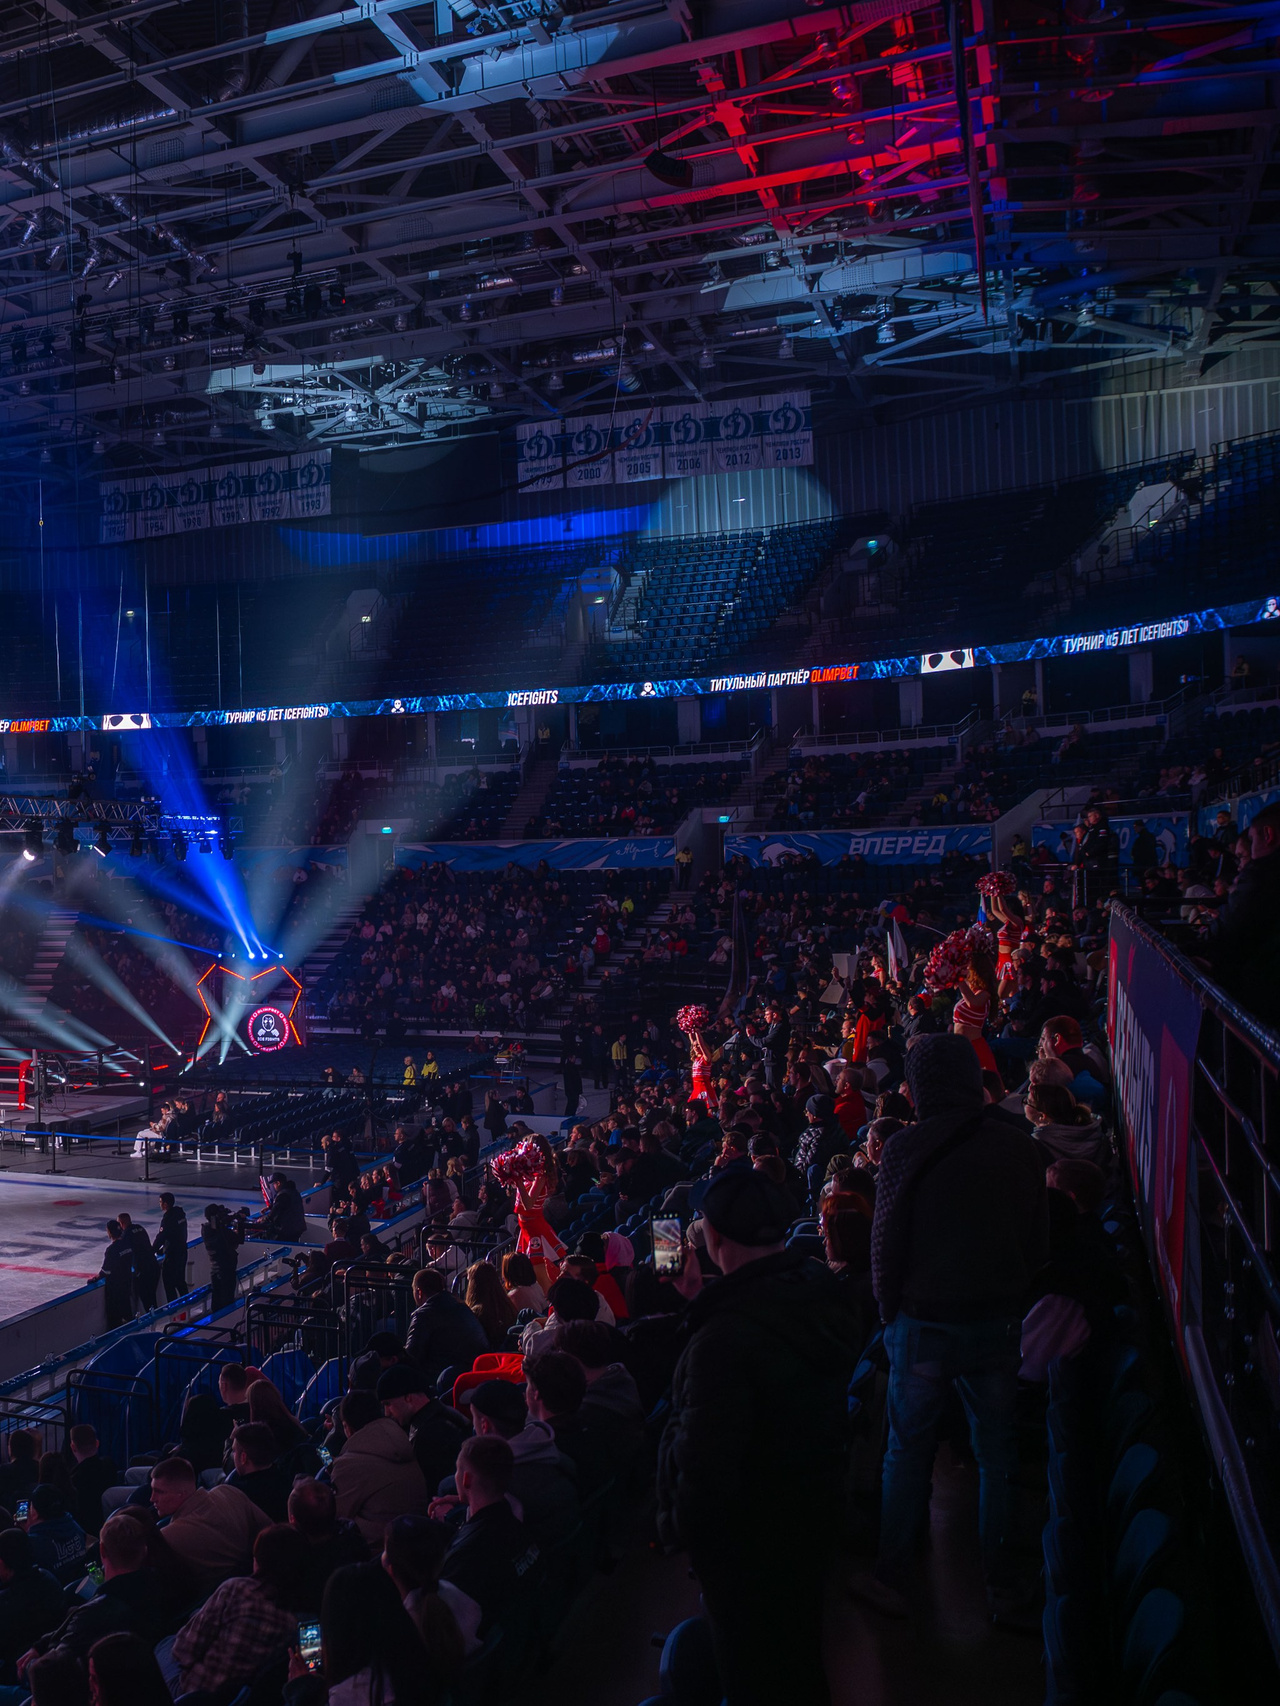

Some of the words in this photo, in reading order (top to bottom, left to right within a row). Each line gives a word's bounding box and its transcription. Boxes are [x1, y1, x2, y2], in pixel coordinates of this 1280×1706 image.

[726, 453, 750, 466] 2012
[776, 447, 801, 461] 2013
[627, 462, 651, 475] 2005
[677, 458, 701, 470] 2006
[578, 467, 601, 480] 2000
[1063, 634, 1104, 653] ТУРНИР
[1120, 627, 1139, 645] ЛЕТ
[710, 672, 767, 691] ТИТУЛЬНЫЙ
[767, 668, 810, 687] ПАРТНЁР
[810, 665, 860, 683] OLIMPBET
[507, 690, 558, 706] ICEFIGHTS
[225, 710, 255, 724] ТУРНИР
[267, 708, 284, 721] ЛЕТ
[10, 719, 50, 733] OLIMPBET
[848, 831, 947, 857] ВПЕРЁД
